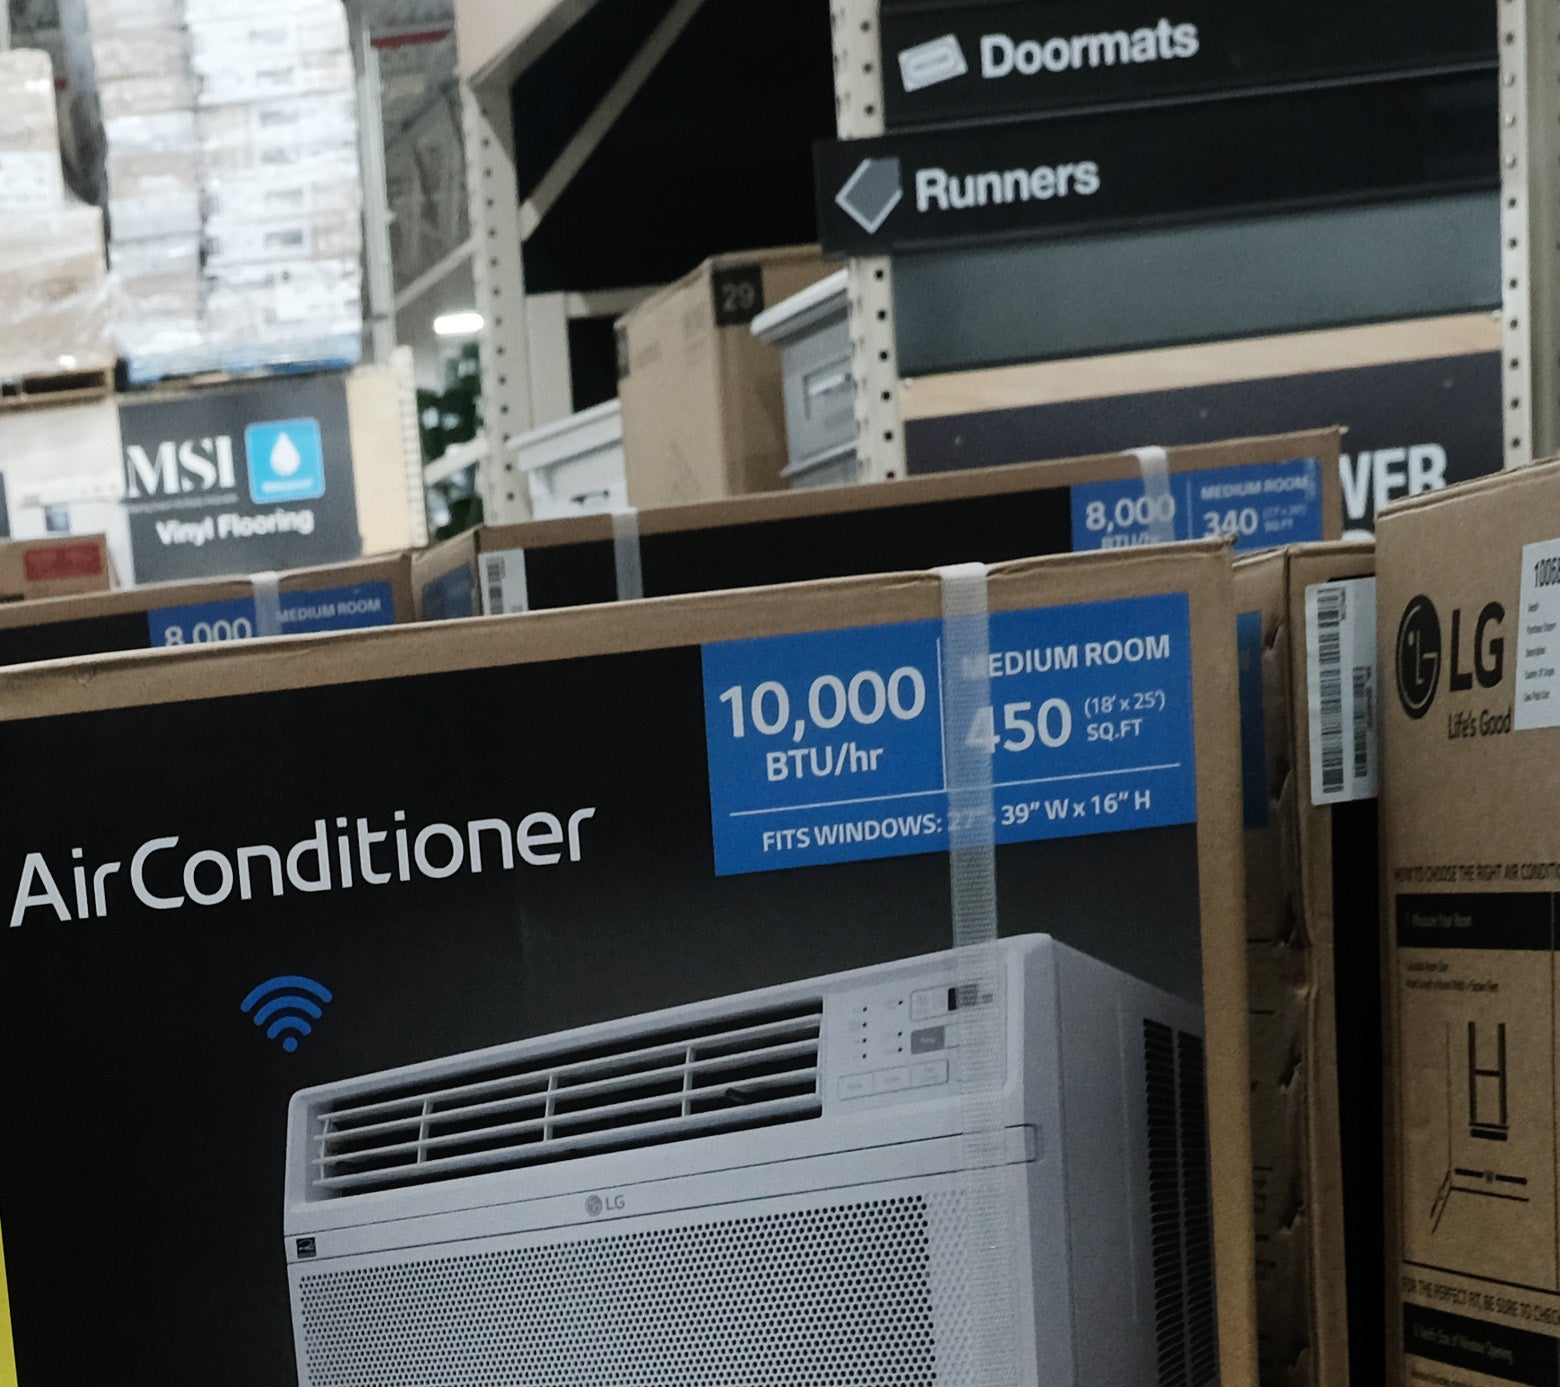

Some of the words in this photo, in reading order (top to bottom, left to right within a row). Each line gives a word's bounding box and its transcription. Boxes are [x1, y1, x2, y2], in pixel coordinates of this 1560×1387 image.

[978, 19, 1200, 79] Doormats
[914, 160, 1101, 213] Runners
[124, 435, 235, 501] MSI
[1199, 478, 1258, 503] MEDIUM
[1260, 472, 1310, 498] ROOM
[156, 517, 210, 547] Vinyl
[218, 508, 314, 544] Flooring
[1085, 491, 1176, 532] 8,000
[1203, 506, 1258, 538] 340
[276, 603, 335, 624] MEDIUM
[338, 598, 382, 617] ROOM
[1085, 634, 1171, 665] ROOM
[1448, 601, 1506, 692] LG
[719, 665, 926, 742] 10,000
[1448, 708, 1479, 739] Life's
[1481, 705, 1511, 736] Good
[964, 698, 1072, 752] 450
[1086, 719, 1142, 741] SQ.FT
[766, 742, 884, 781] BTU/hr
[762, 829, 810, 852] FITS
[815, 812, 942, 846] WINDOWS:
[1044, 799, 1069, 820] W
[1134, 791, 1151, 810] H
[10, 847, 119, 929] Air
[130, 805, 596, 911] Conditioner
